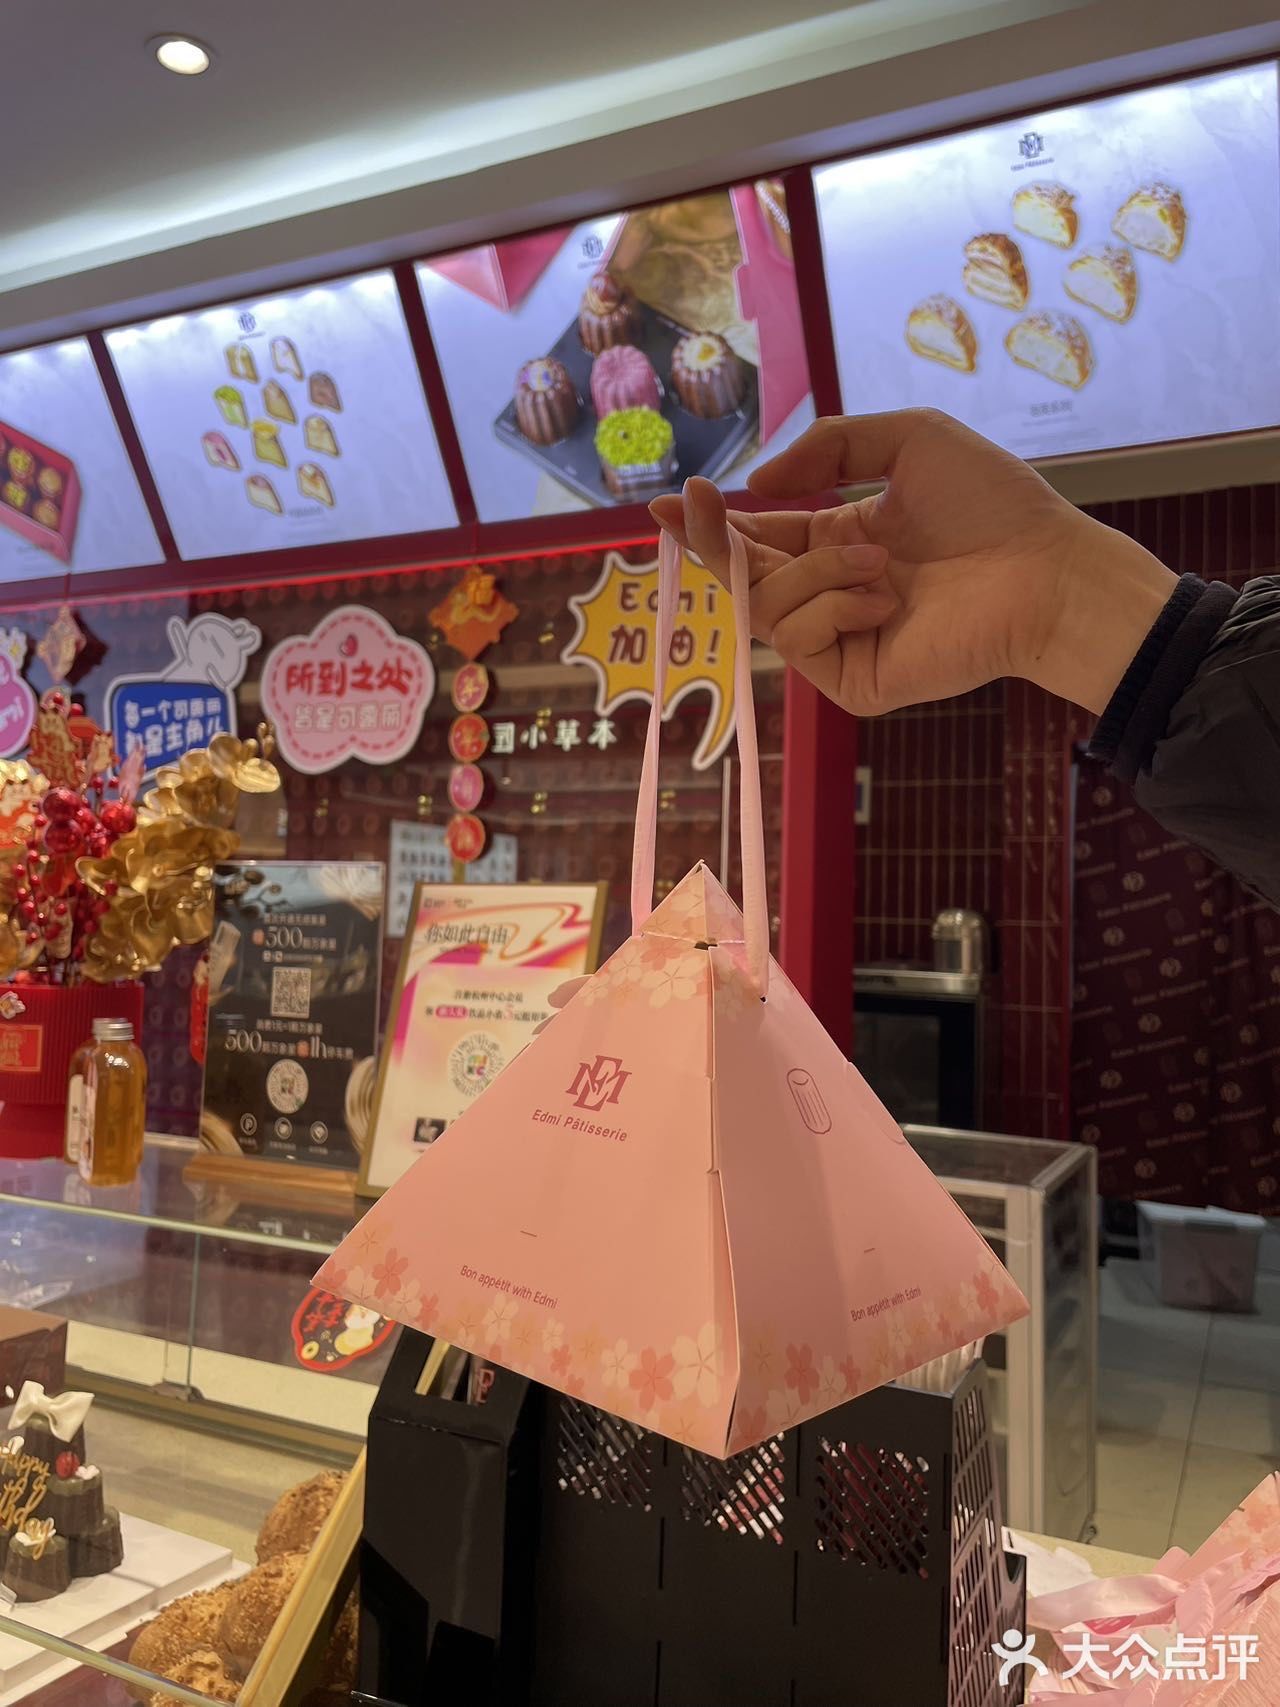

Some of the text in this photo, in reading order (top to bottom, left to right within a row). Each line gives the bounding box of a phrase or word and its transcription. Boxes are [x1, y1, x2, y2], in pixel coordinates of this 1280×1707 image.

[532, 1109, 628, 1142] Edmi Pâtisserie
[460, 1265, 478, 1281] Bon
[512, 1285, 532, 1300] with
[533, 1291, 558, 1309] Edmi
[850, 1308, 867, 1322] Bon
[891, 1292, 906, 1306] with
[904, 1286, 922, 1301] Edmi
